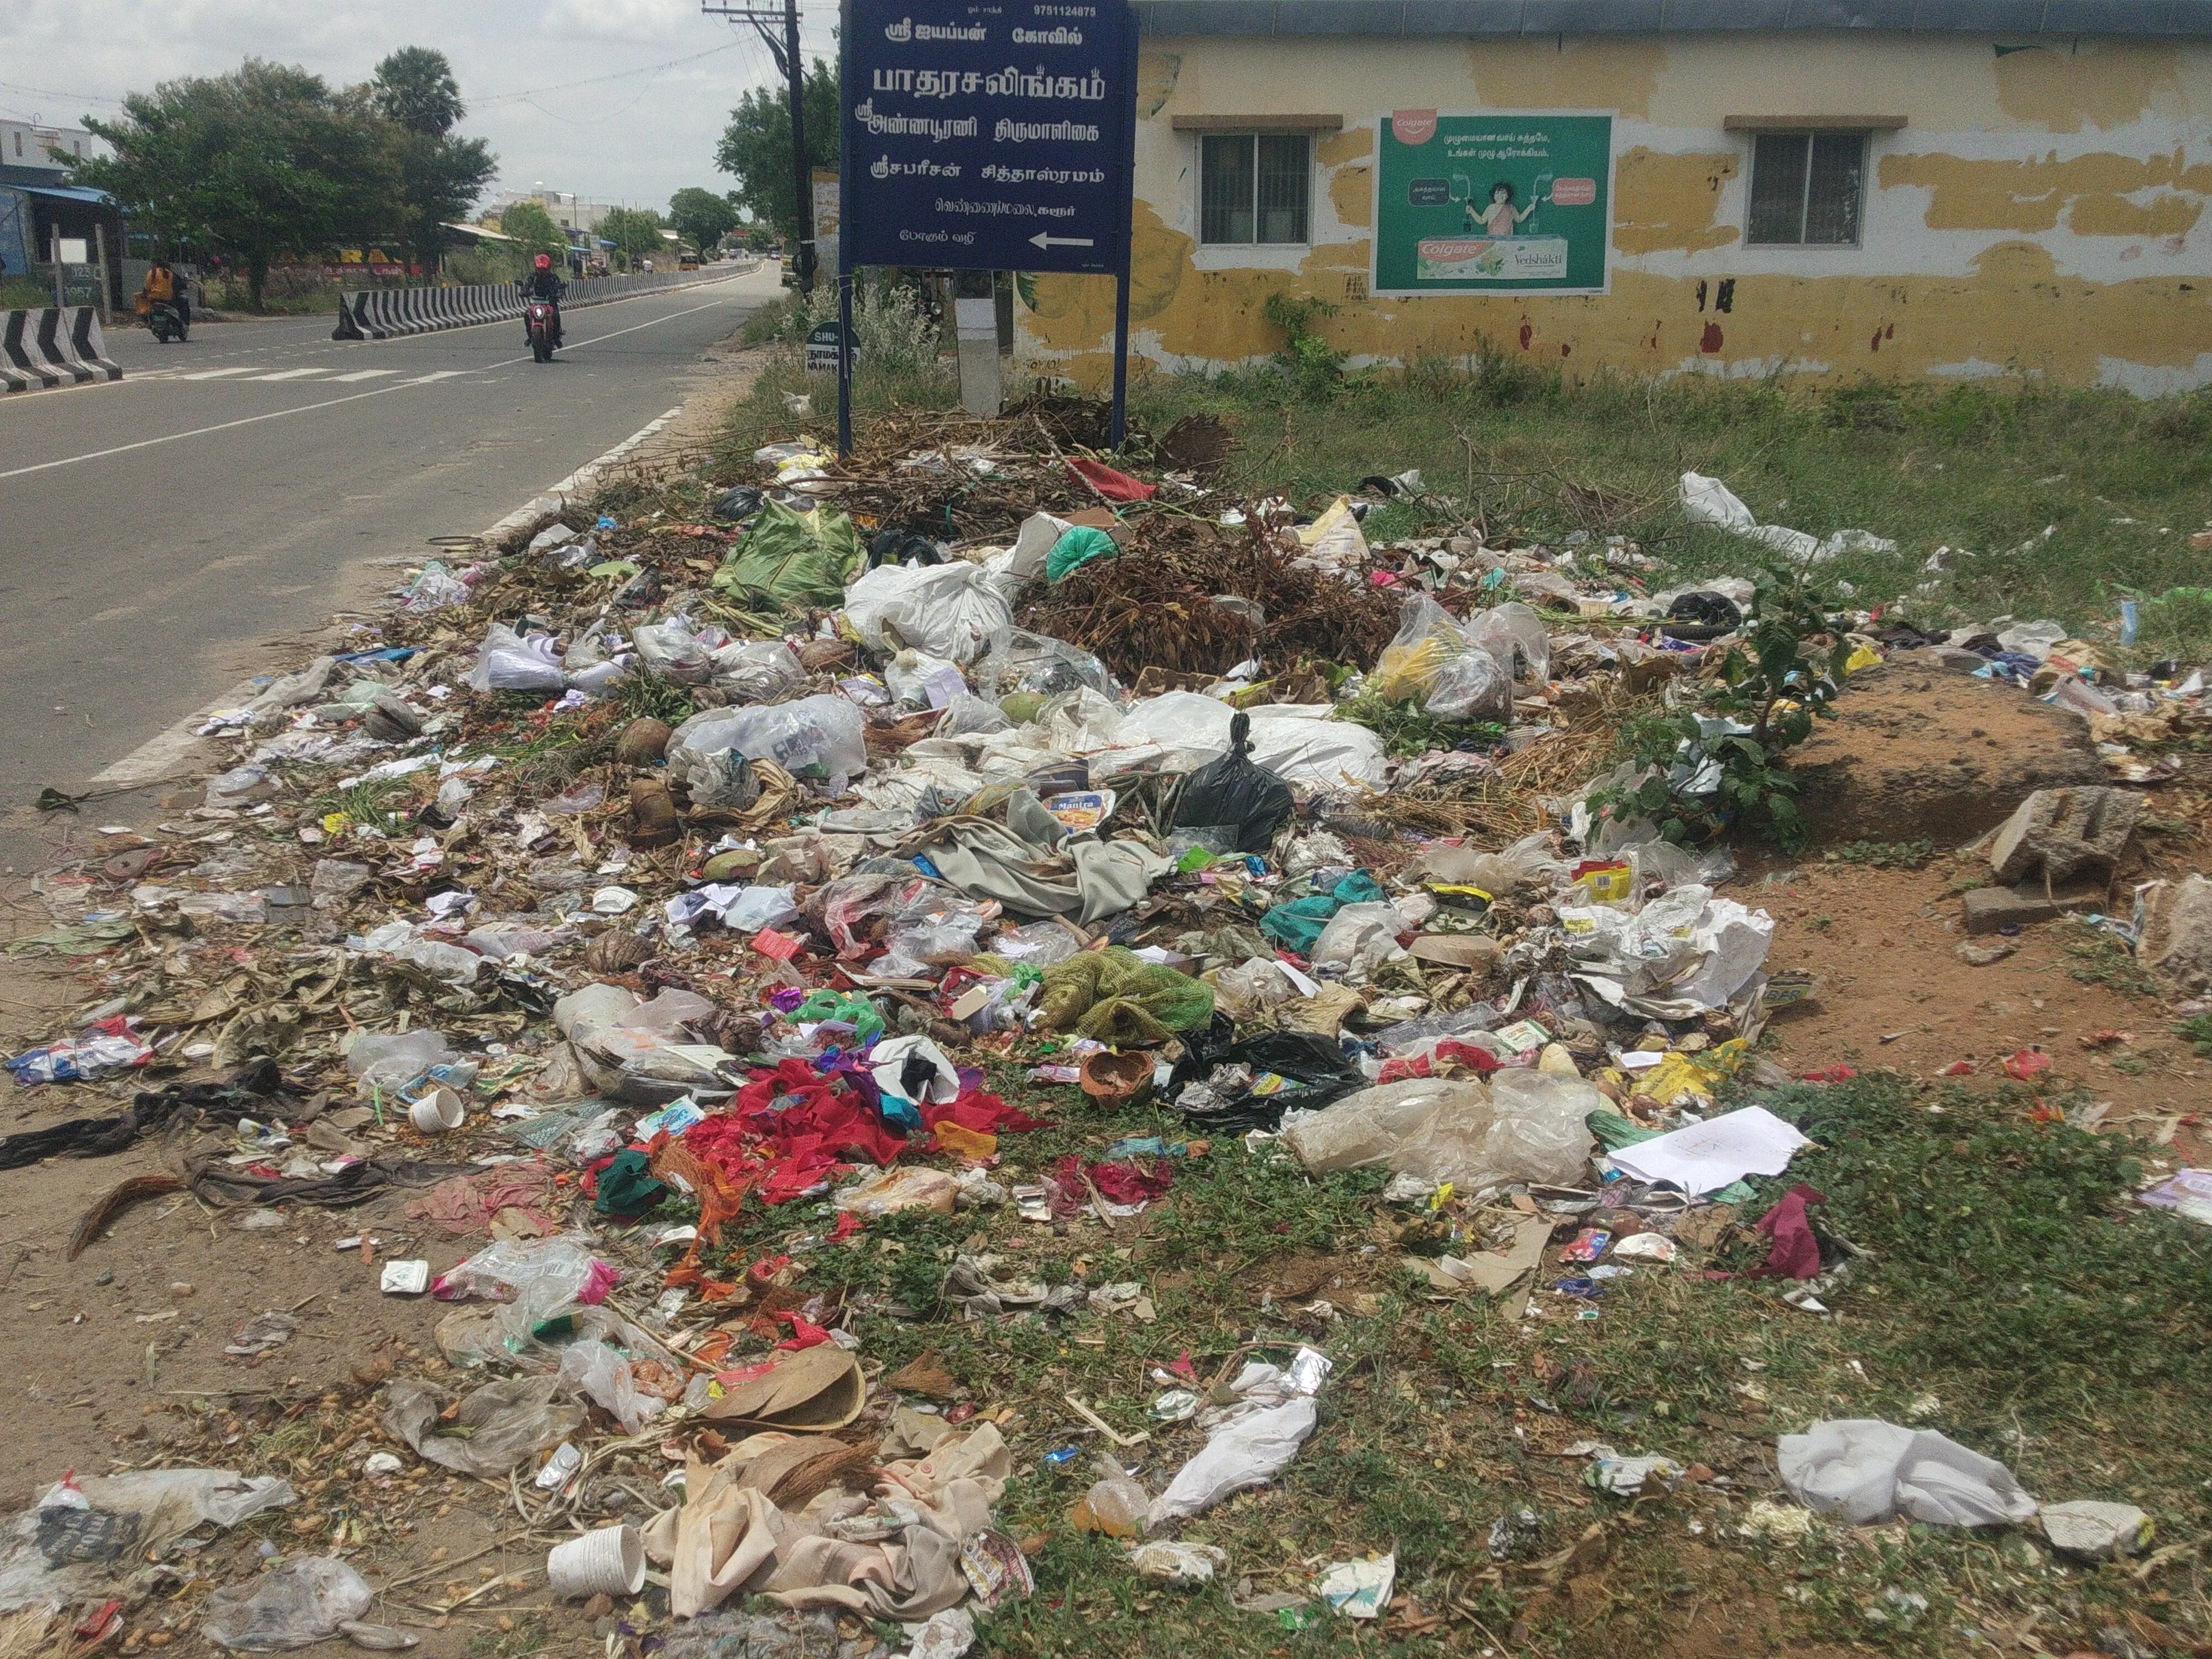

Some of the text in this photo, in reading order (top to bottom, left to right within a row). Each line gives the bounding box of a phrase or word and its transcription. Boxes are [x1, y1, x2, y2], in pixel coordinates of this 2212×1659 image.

[915, 21, 987, 41] ஐயப்பன்
[1012, 27, 1083, 45] கோவில்
[873, 64, 1105, 100] பாதரசலிங்கம்
[1397, 118, 1433, 127] Colgate
[993, 118, 1099, 143] திருமாளிகை
[1447, 148, 1476, 158] உங்கள்
[981, 164, 1105, 184] சித்தாஸ்ரமம்
[899, 229, 977, 246] போகும் வழி
[1422, 243, 1476, 257] Colgate
[1515, 253, 1562, 265] Vedshakti
[1058, 801, 1093, 811] Mantra
